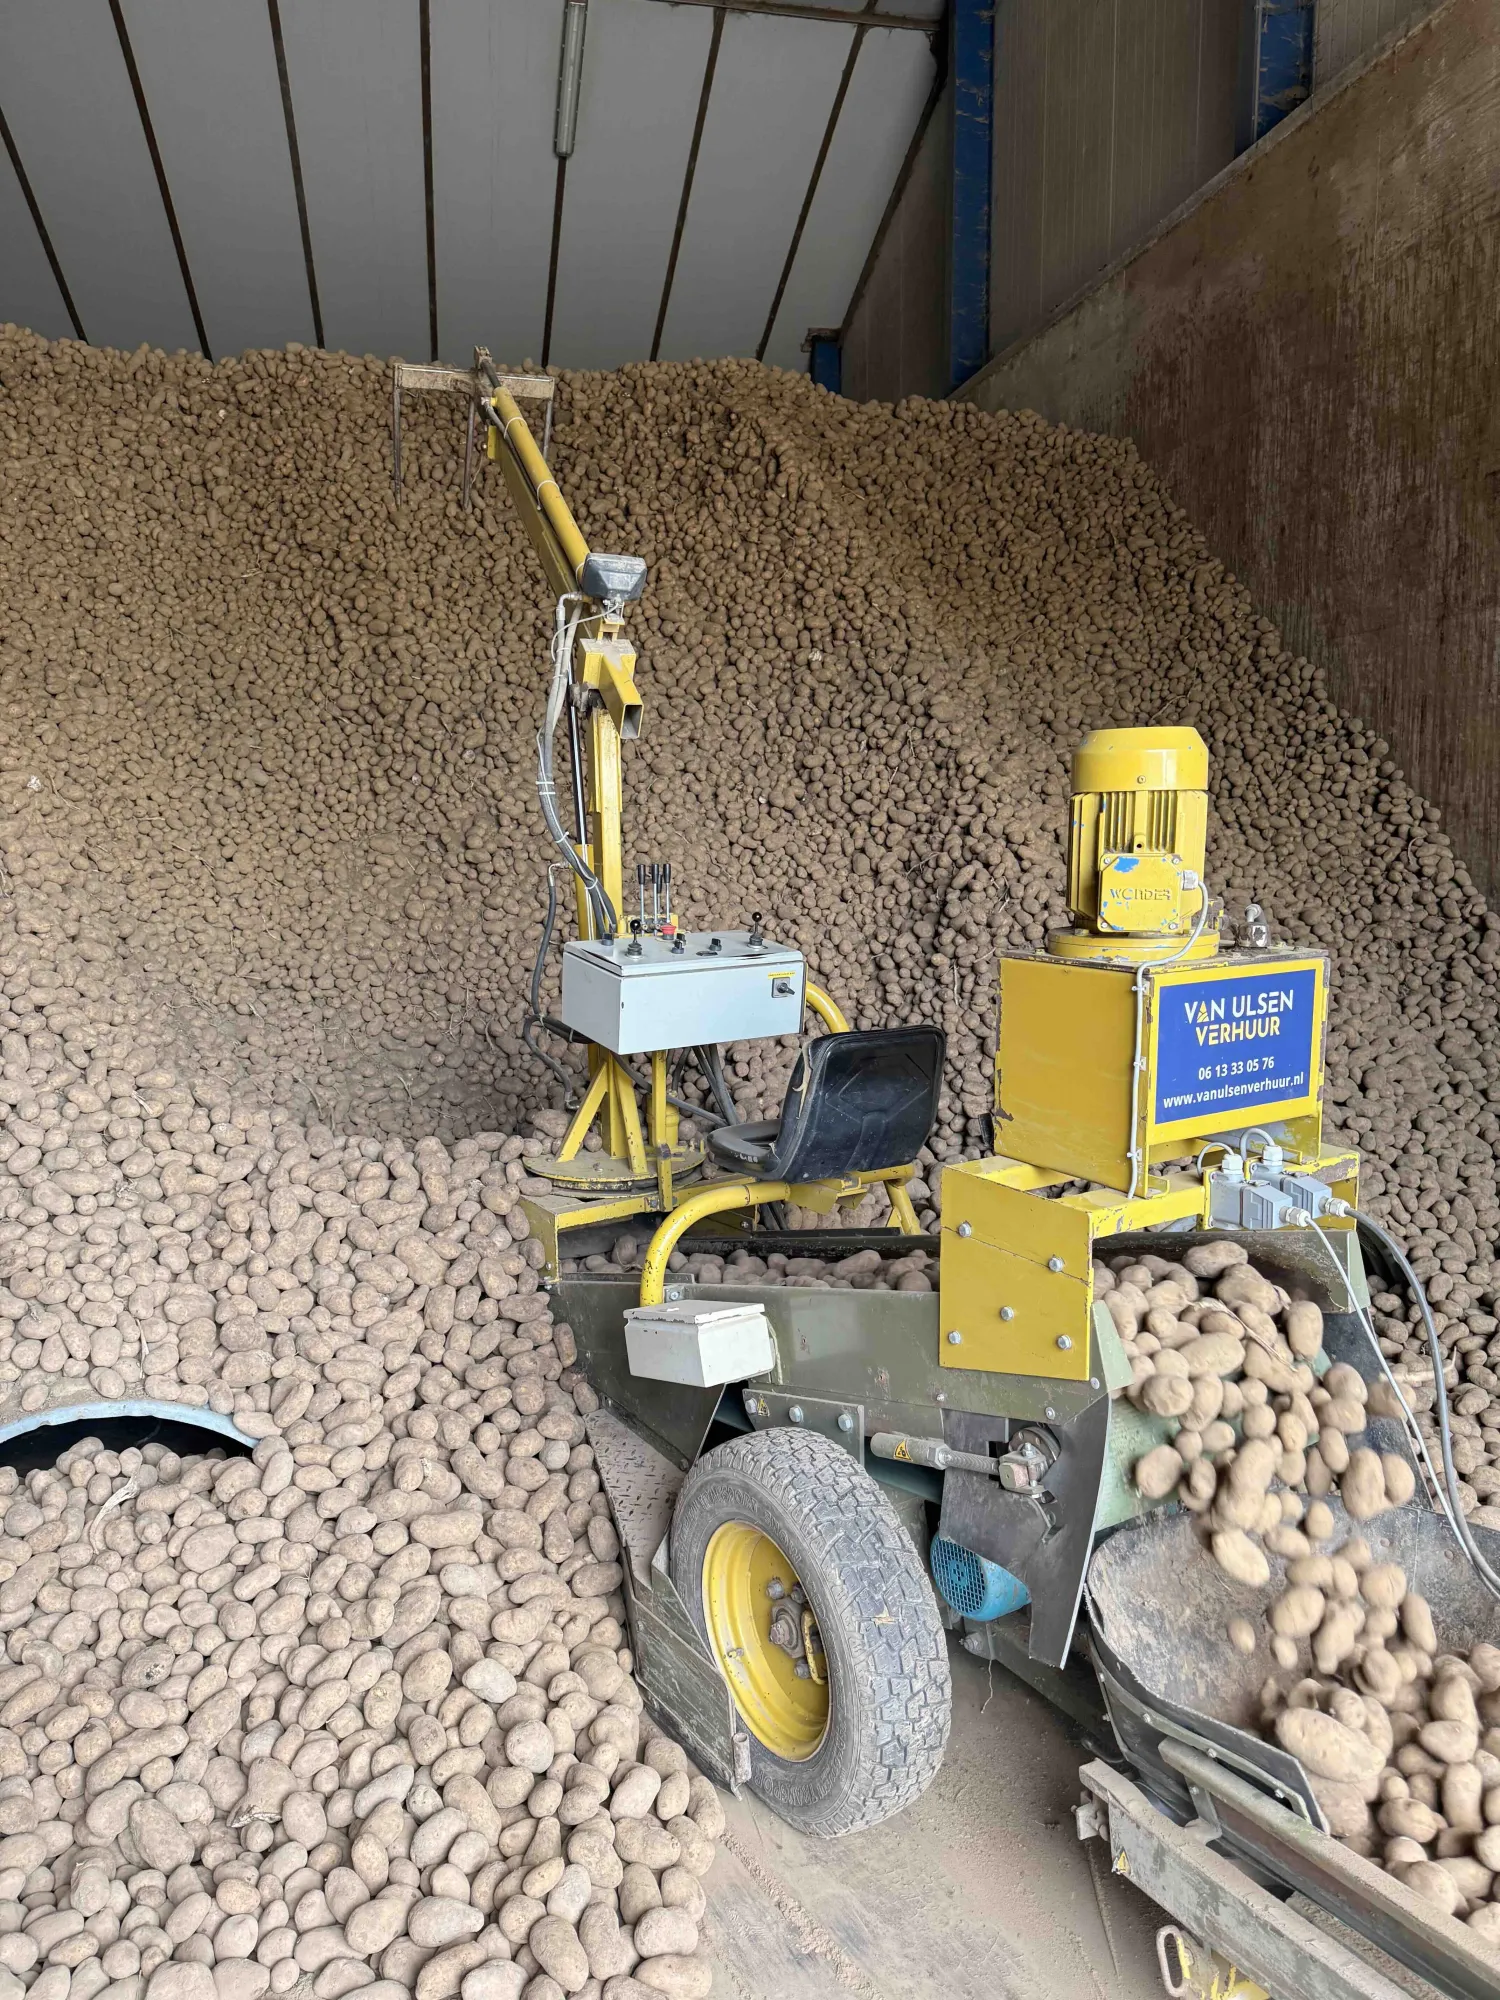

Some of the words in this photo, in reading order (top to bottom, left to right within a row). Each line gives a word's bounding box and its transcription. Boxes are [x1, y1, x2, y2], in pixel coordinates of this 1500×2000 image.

[1184, 997, 1225, 1025] VAN
[1232, 989, 1294, 1018] ULSEN
[1195, 1016, 1280, 1047] VERHUUR
[1198, 1066, 1212, 1081] 06
[1215, 1063, 1228, 1078] 13
[1231, 1061, 1244, 1076] 33
[1246, 1058, 1259, 1073] 05
[1262, 1056, 1275, 1071] 76
[1163, 1072, 1304, 1109] www.vanulsenverhuur.nl
